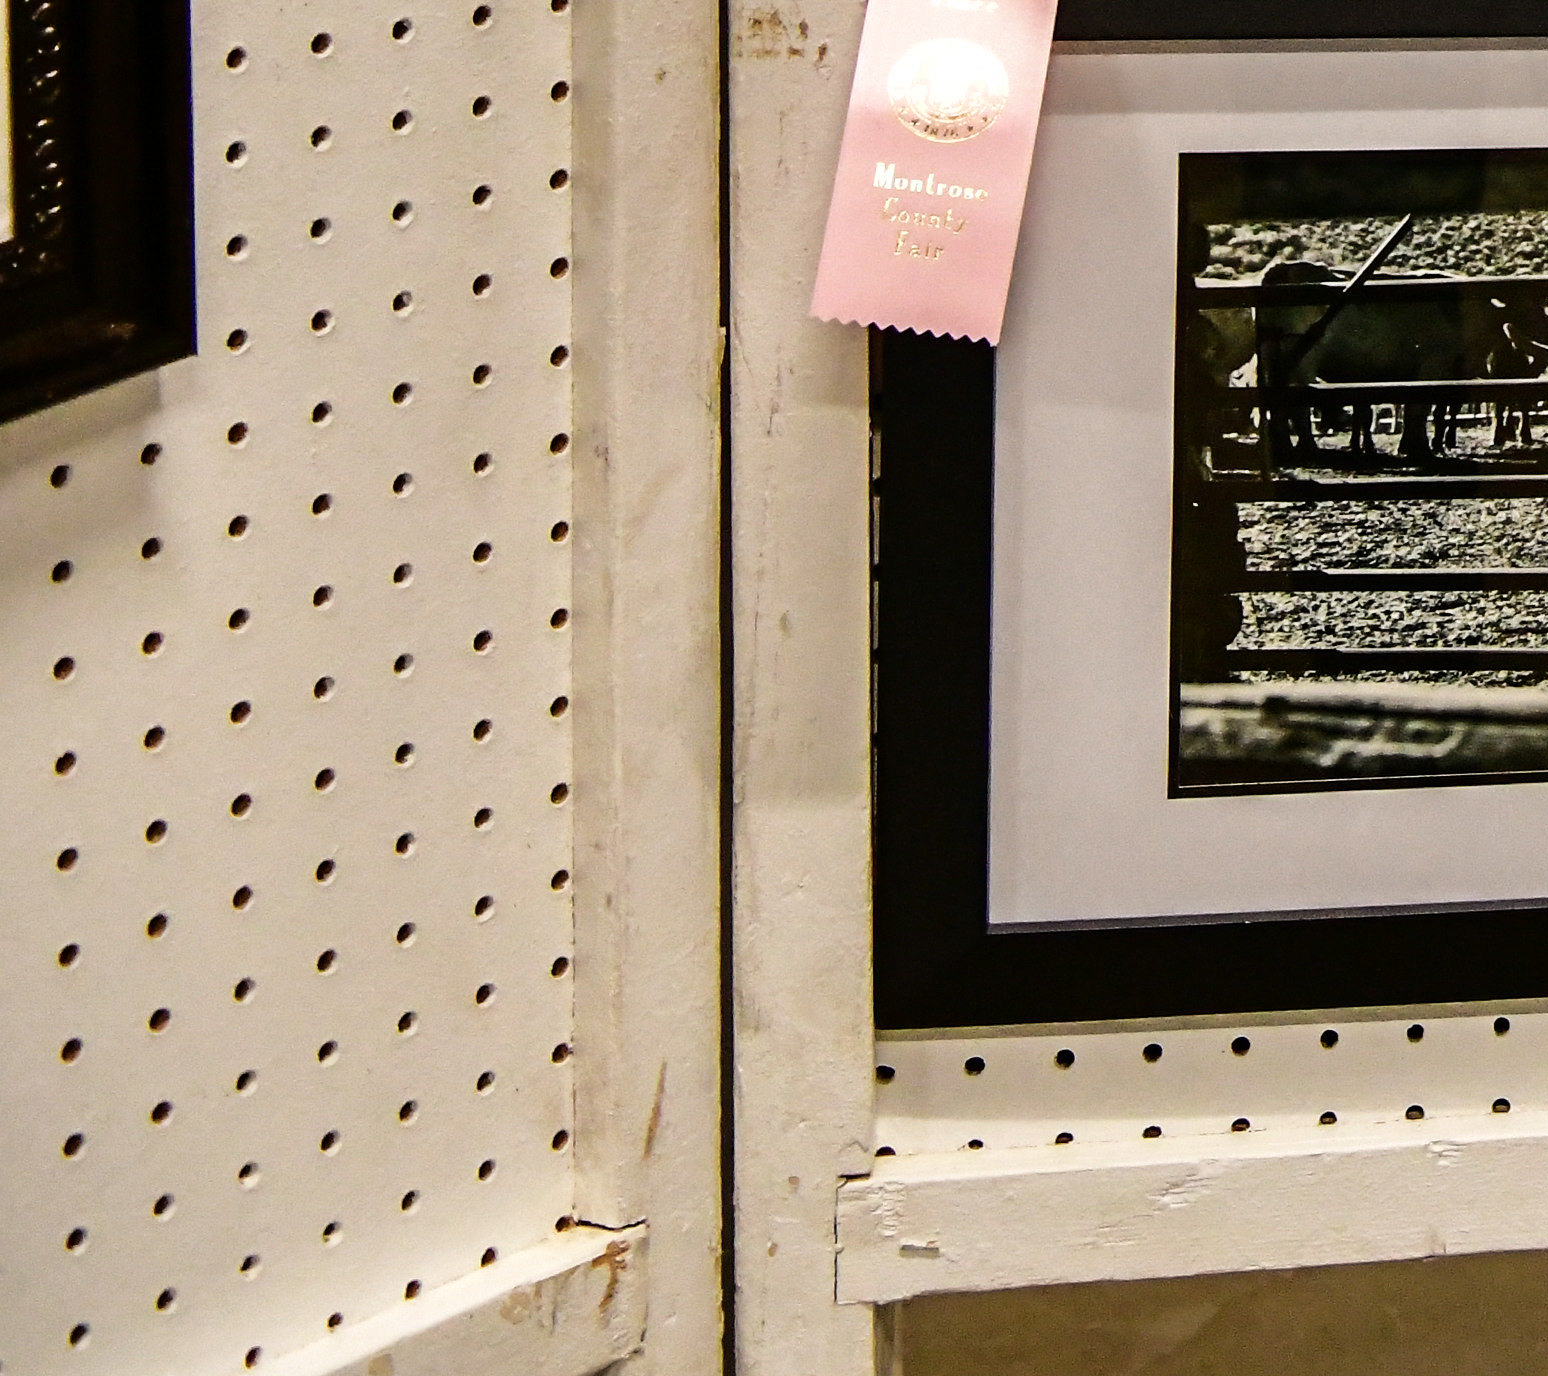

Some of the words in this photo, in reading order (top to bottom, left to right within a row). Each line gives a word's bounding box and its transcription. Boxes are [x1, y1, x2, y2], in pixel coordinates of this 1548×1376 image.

[873, 162, 988, 202] Montrose
[881, 197, 969, 235] County
[893, 230, 945, 260] Fair
